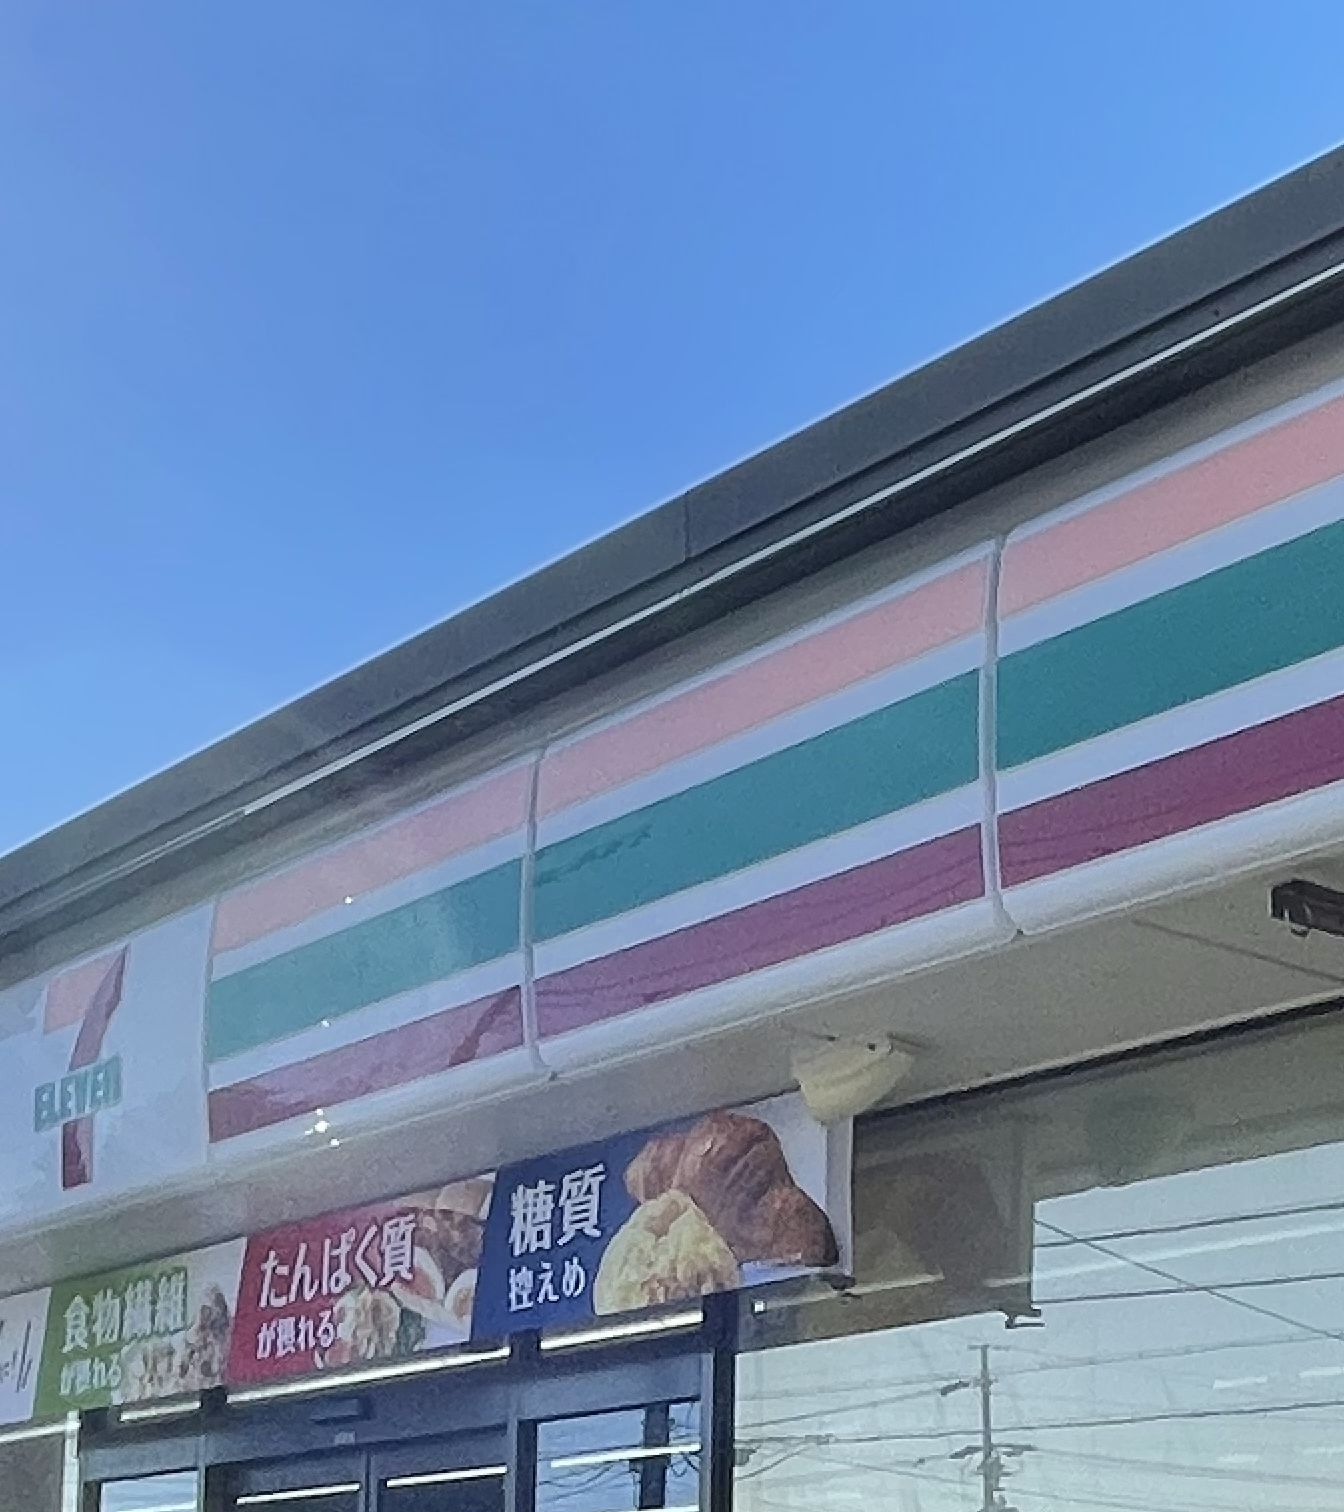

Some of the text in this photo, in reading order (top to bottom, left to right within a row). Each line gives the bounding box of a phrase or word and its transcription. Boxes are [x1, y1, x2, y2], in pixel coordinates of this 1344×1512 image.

[508, 1162, 607, 1257] 糖質
[258, 1214, 416, 1309] たんぱく質
[508, 1256, 586, 1313] 控えめ
[256, 1310, 335, 1361] が摂れる
